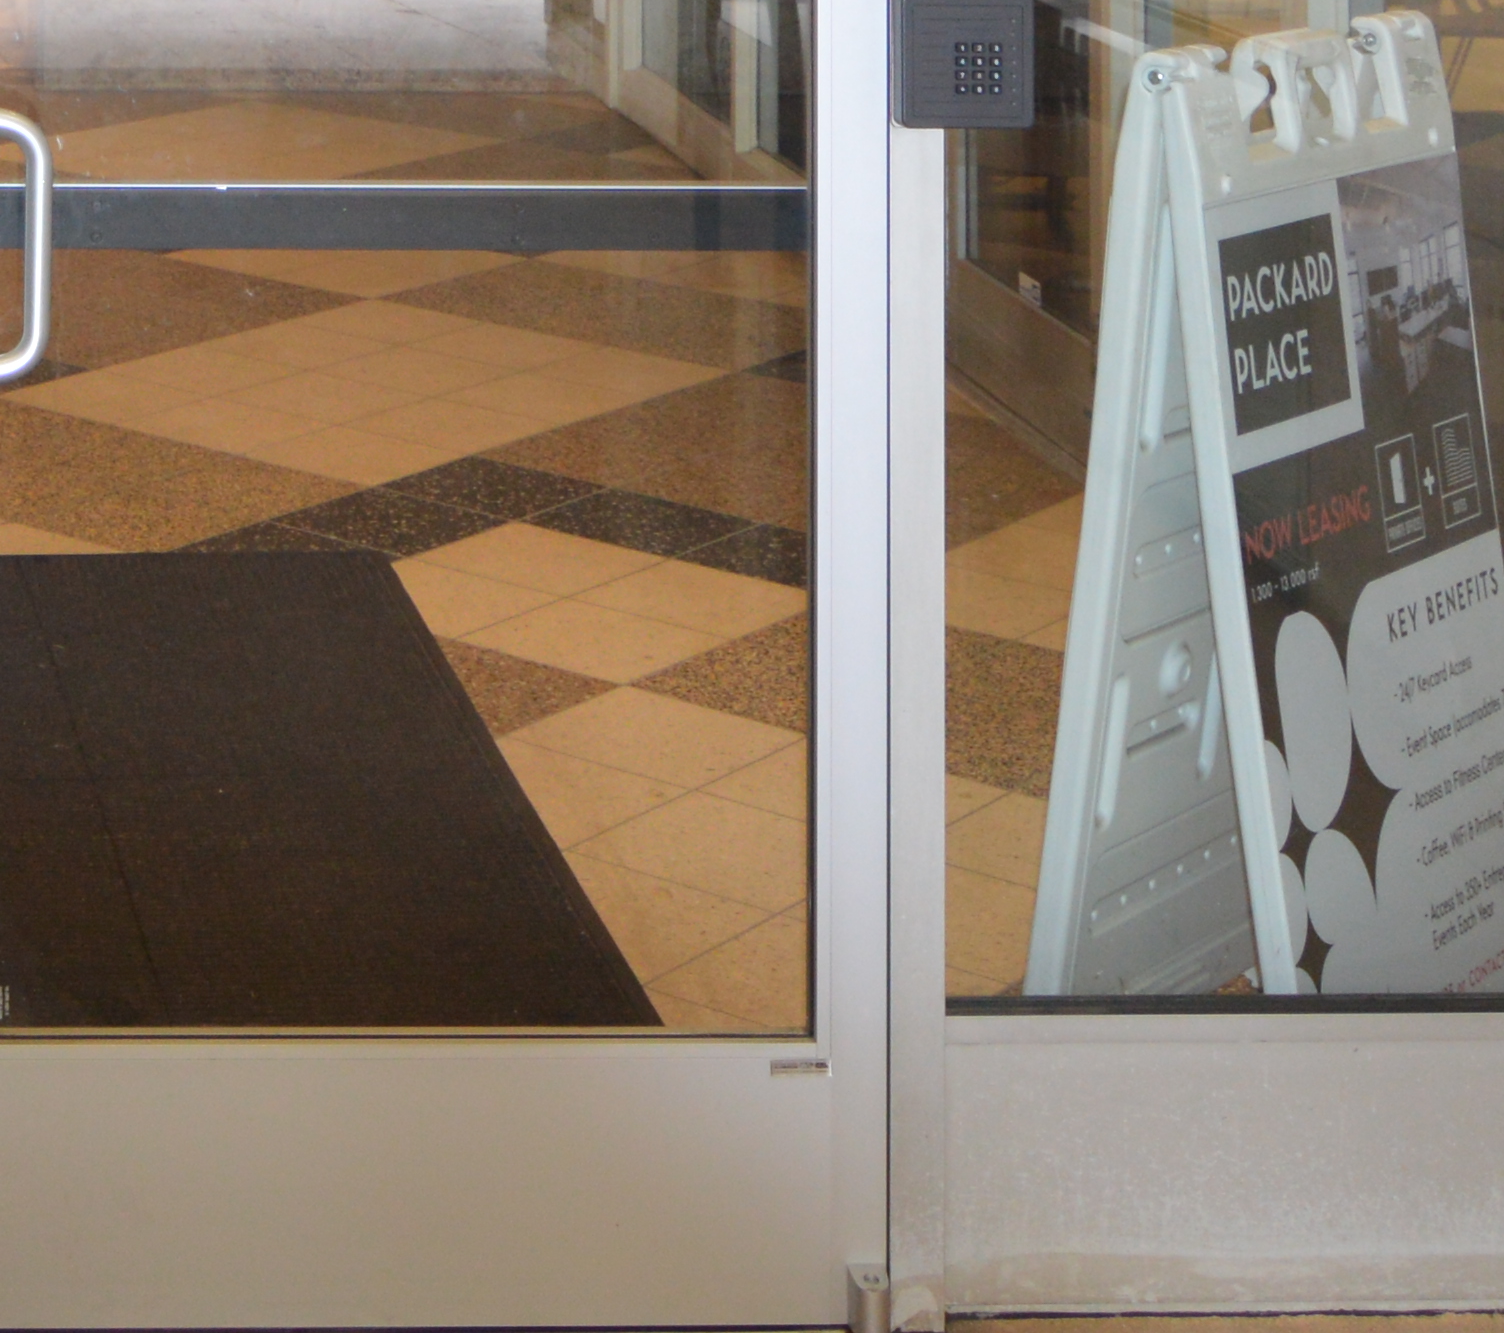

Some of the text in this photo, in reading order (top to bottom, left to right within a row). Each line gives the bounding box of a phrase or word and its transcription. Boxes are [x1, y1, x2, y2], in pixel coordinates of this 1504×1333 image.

[1227, 250, 1334, 323] PACKARD
[1234, 329, 1313, 395] PLACE
[1244, 512, 1292, 565] NOW
[1296, 484, 1373, 546] LEASING
[1386, 567, 1500, 644] KEY BENEFITS
